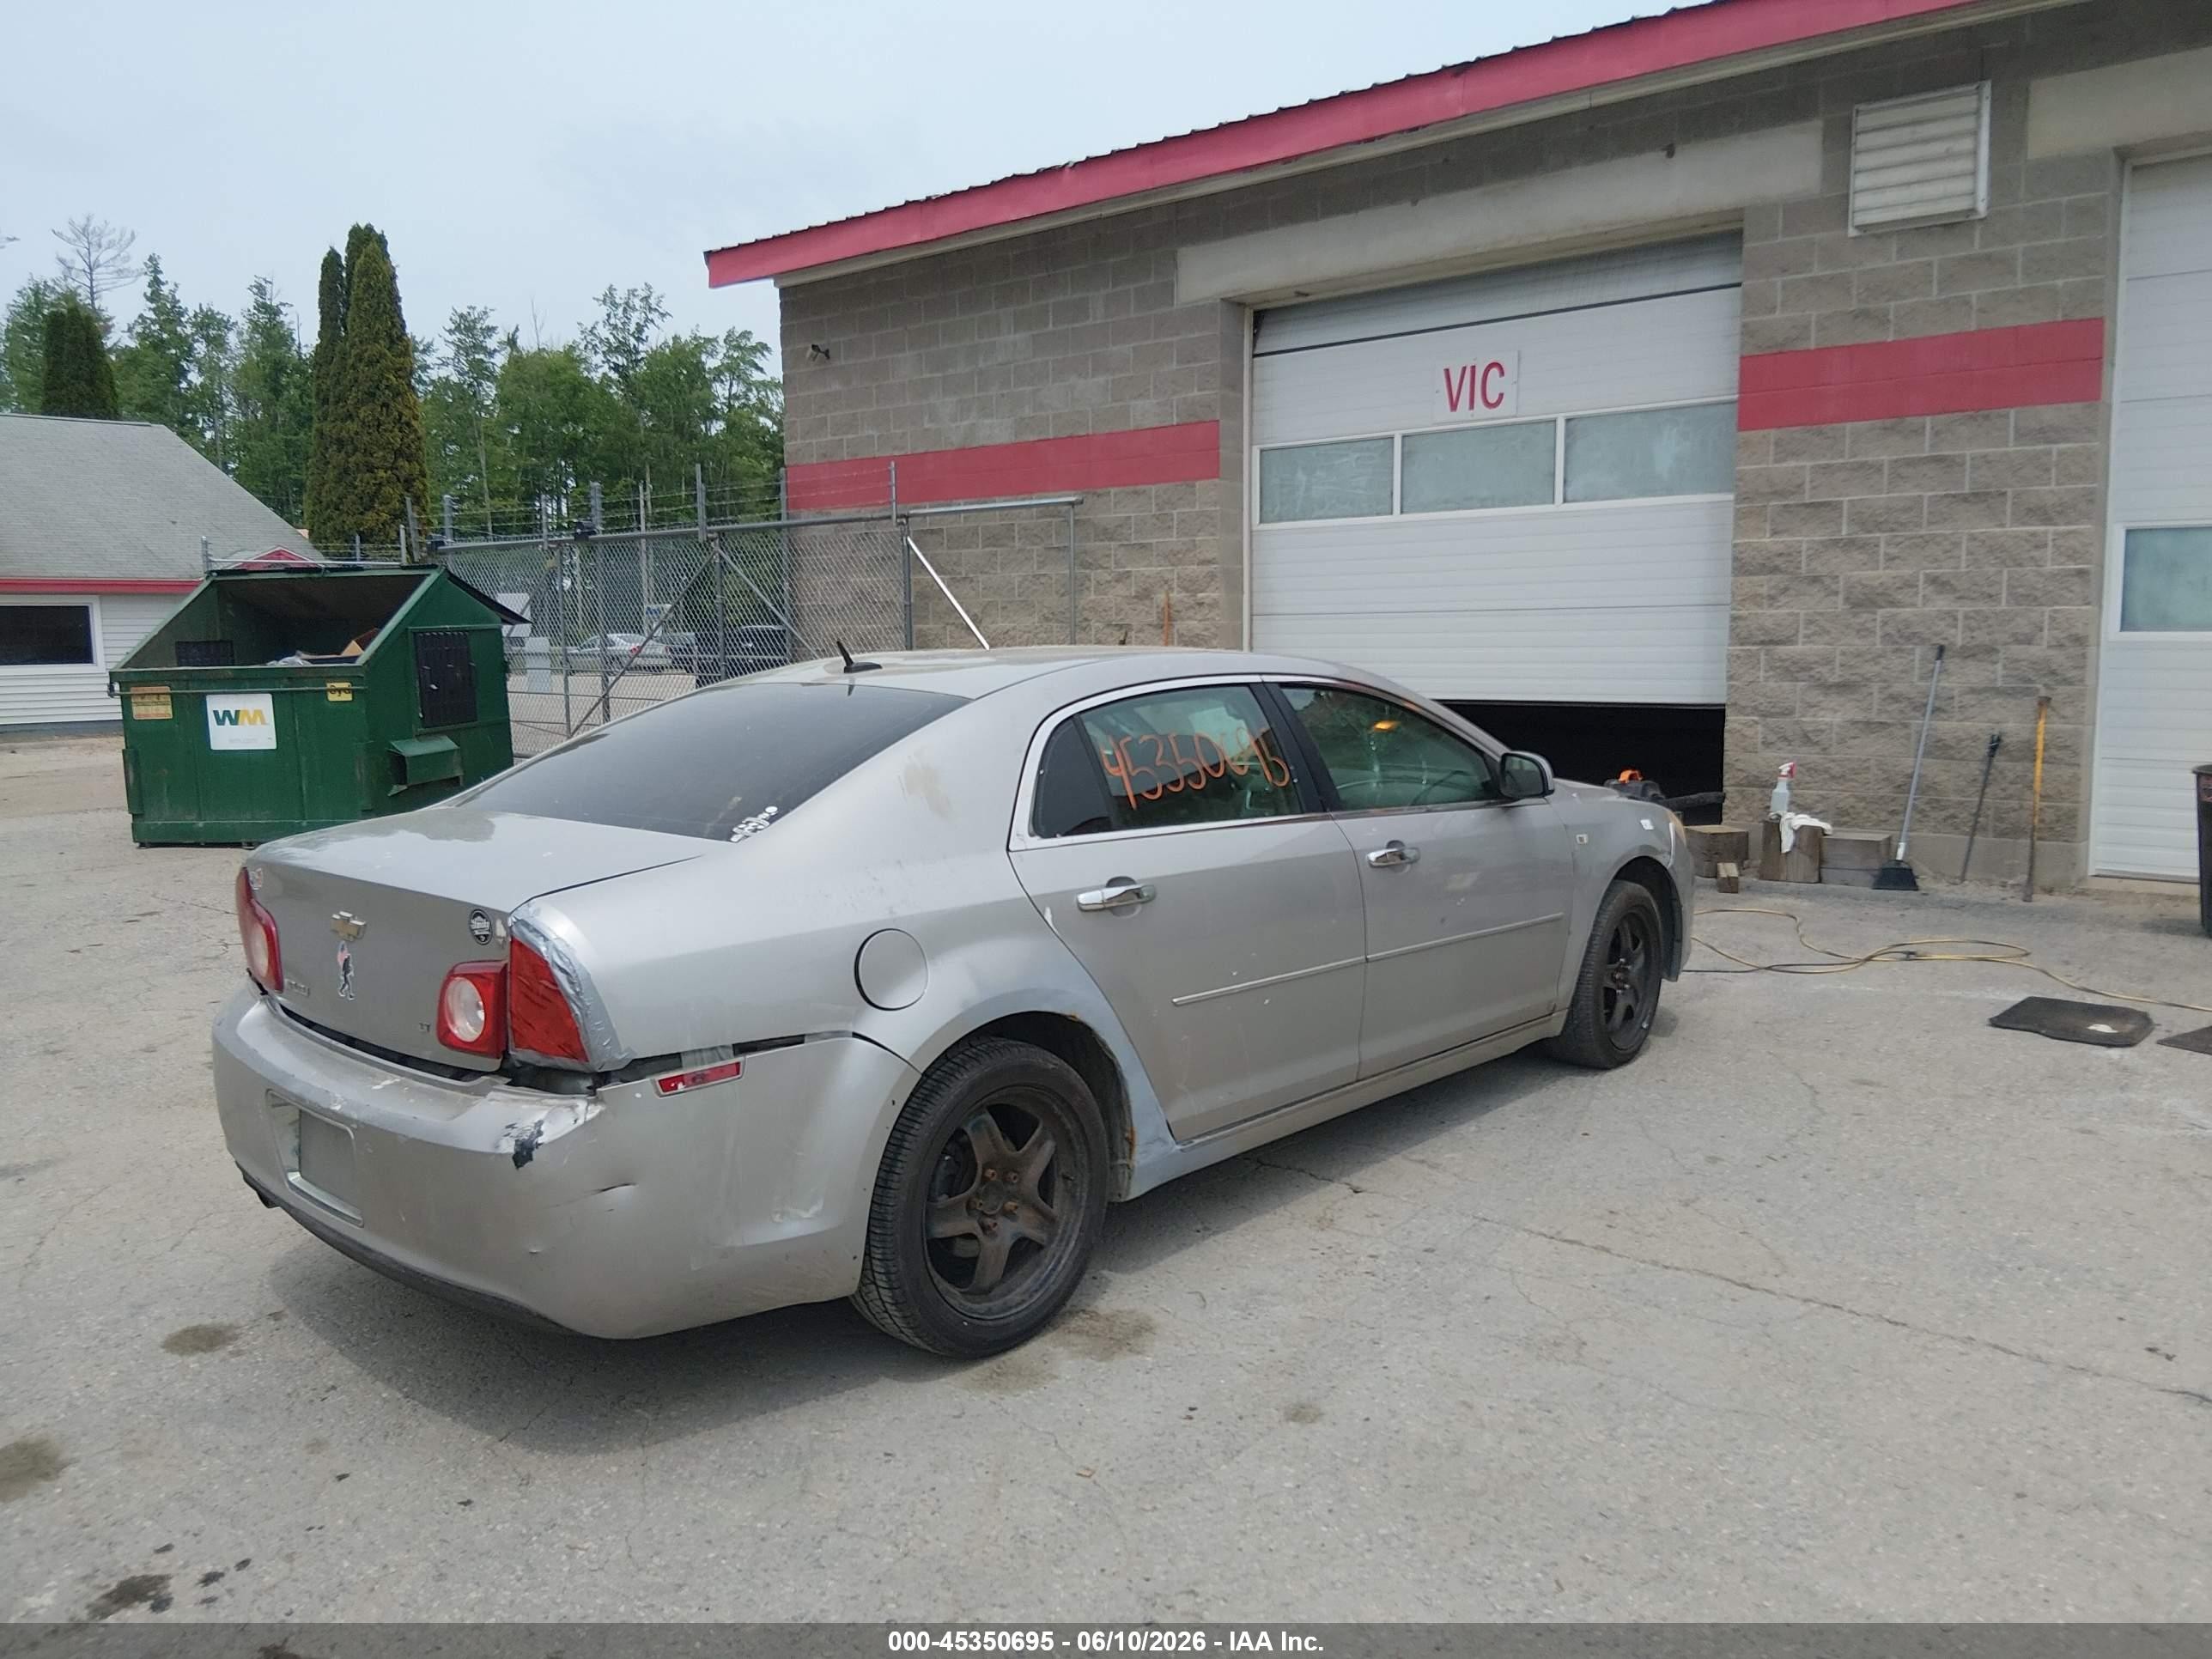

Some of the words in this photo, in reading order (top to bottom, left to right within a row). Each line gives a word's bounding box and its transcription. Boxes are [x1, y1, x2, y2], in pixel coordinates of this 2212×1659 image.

[1443, 361, 1505, 413] VIC
[213, 709, 267, 726] WM
[1099, 727, 1291, 810] 45350695
